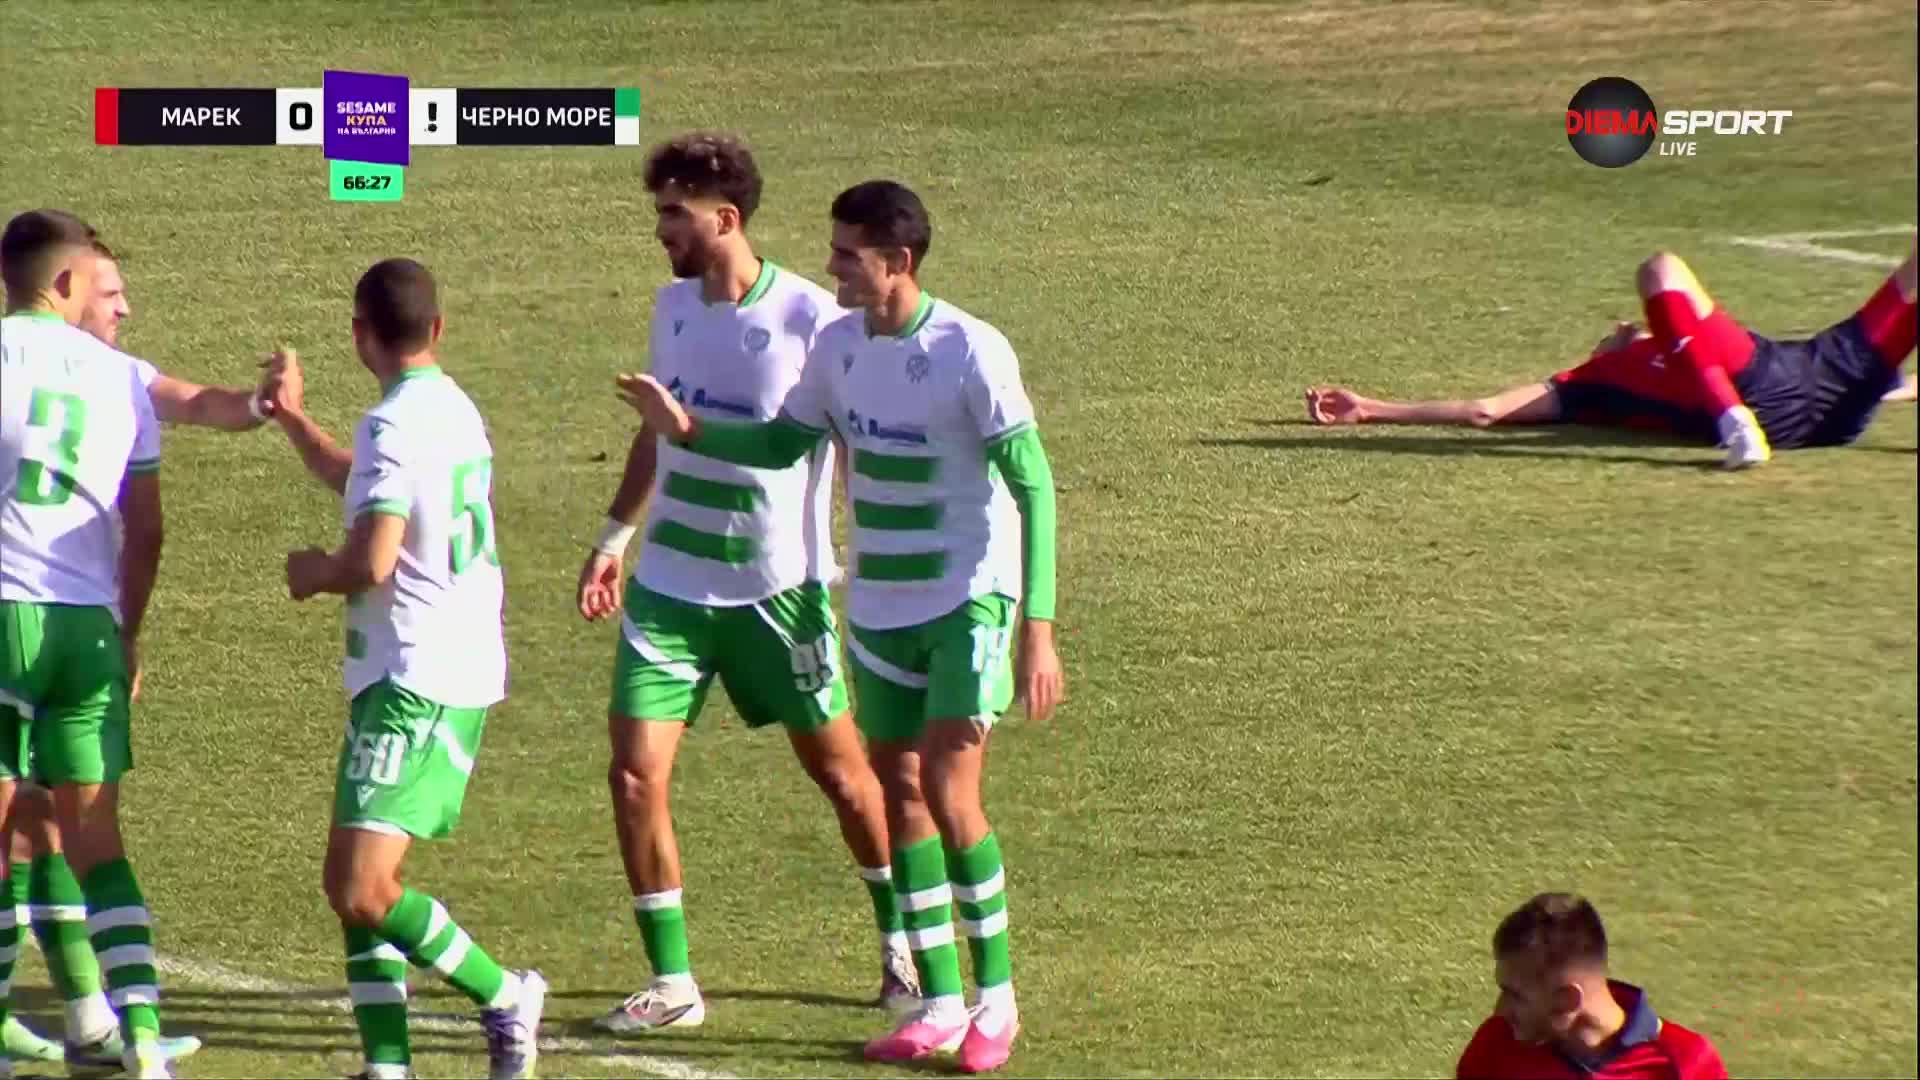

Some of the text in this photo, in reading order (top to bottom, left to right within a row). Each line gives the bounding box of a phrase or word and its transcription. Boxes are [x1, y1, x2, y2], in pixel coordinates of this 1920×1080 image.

[16, 386, 87, 505] 3
[448, 457, 500, 576] 5
[346, 733, 408, 785] 50
